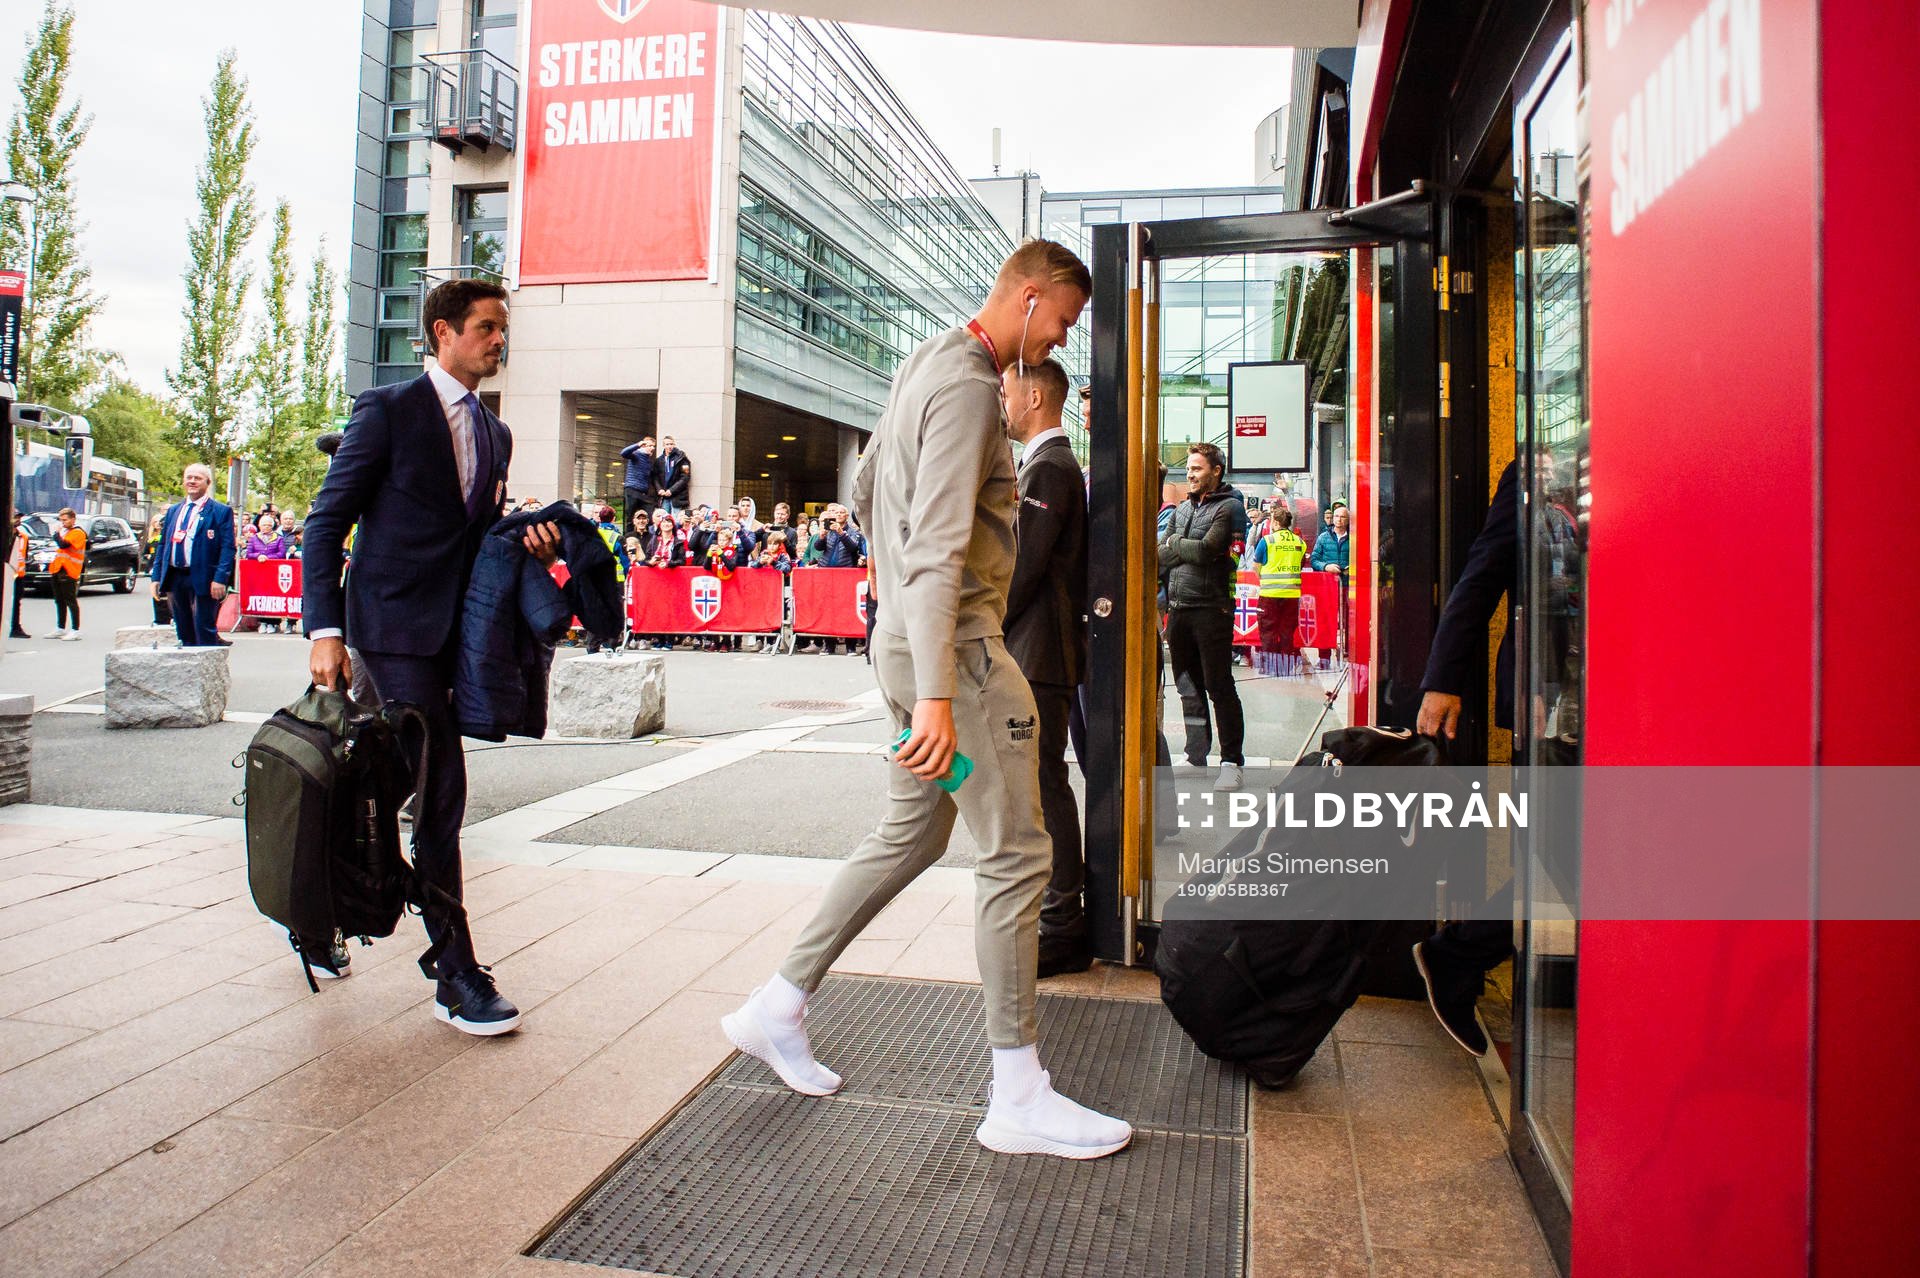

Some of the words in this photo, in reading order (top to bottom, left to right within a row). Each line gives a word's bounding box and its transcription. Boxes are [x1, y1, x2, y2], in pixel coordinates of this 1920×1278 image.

[539, 32, 706, 88] STERKERE
[544, 93, 695, 147] SAMMEN
[1610, 0, 1762, 237] SAMMEN
[1011, 729, 1034, 741] NORGE
